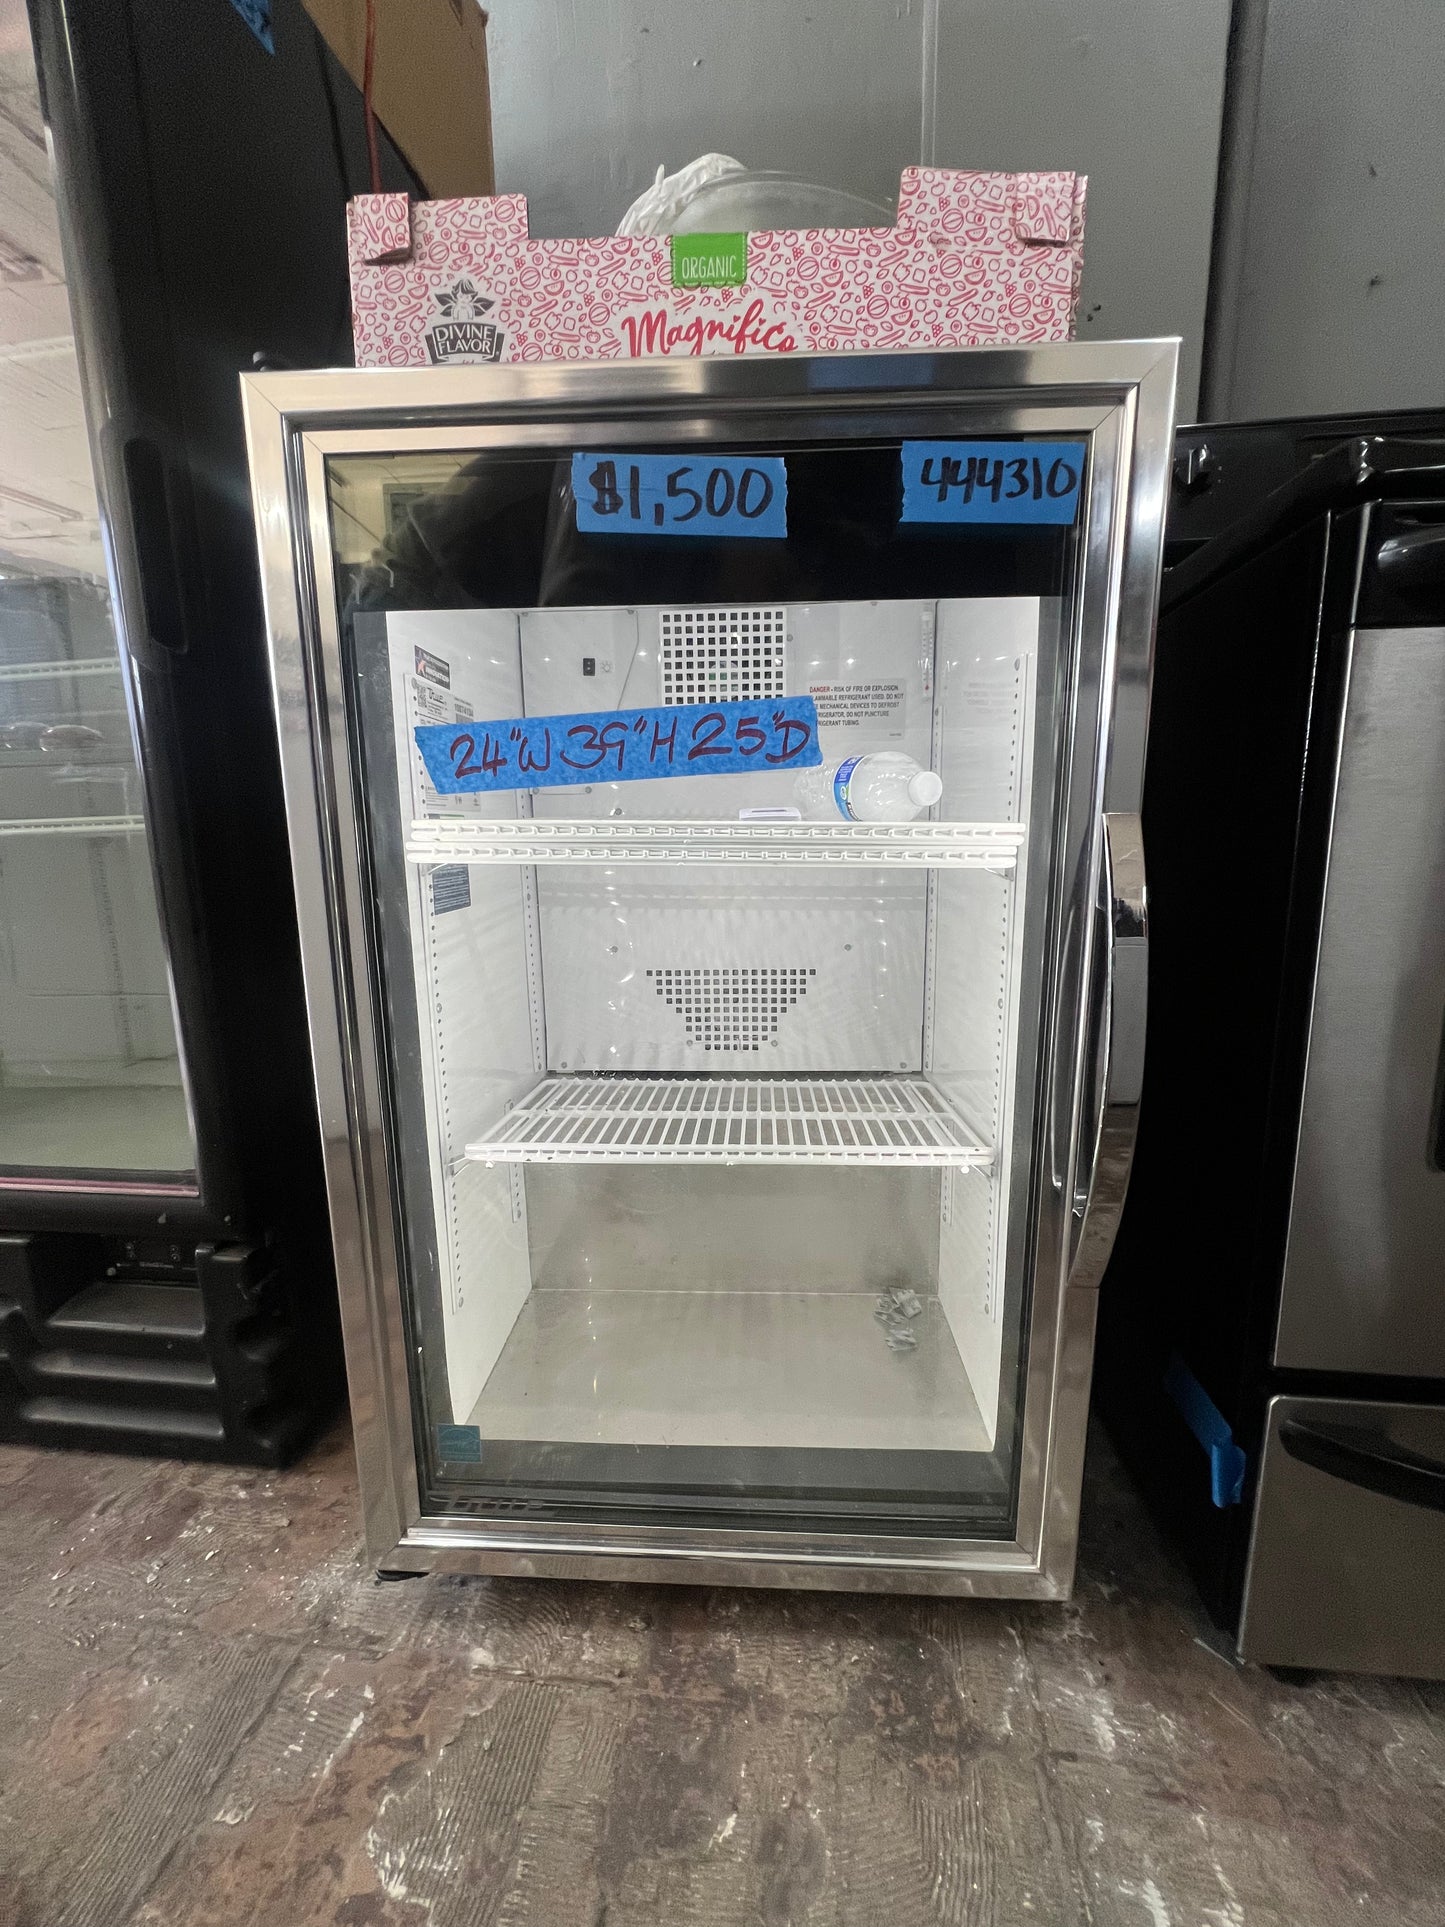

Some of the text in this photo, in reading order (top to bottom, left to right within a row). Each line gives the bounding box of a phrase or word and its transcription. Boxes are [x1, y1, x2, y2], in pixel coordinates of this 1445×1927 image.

[682, 255, 737, 280] ORGANIC
[435, 324, 494, 342] DIVINE
[438, 338, 491, 354] FLAVOR
[621, 299, 798, 358] Magnifico
[589, 461, 773, 526] $1,500
[921, 456, 1077, 504] 444310
